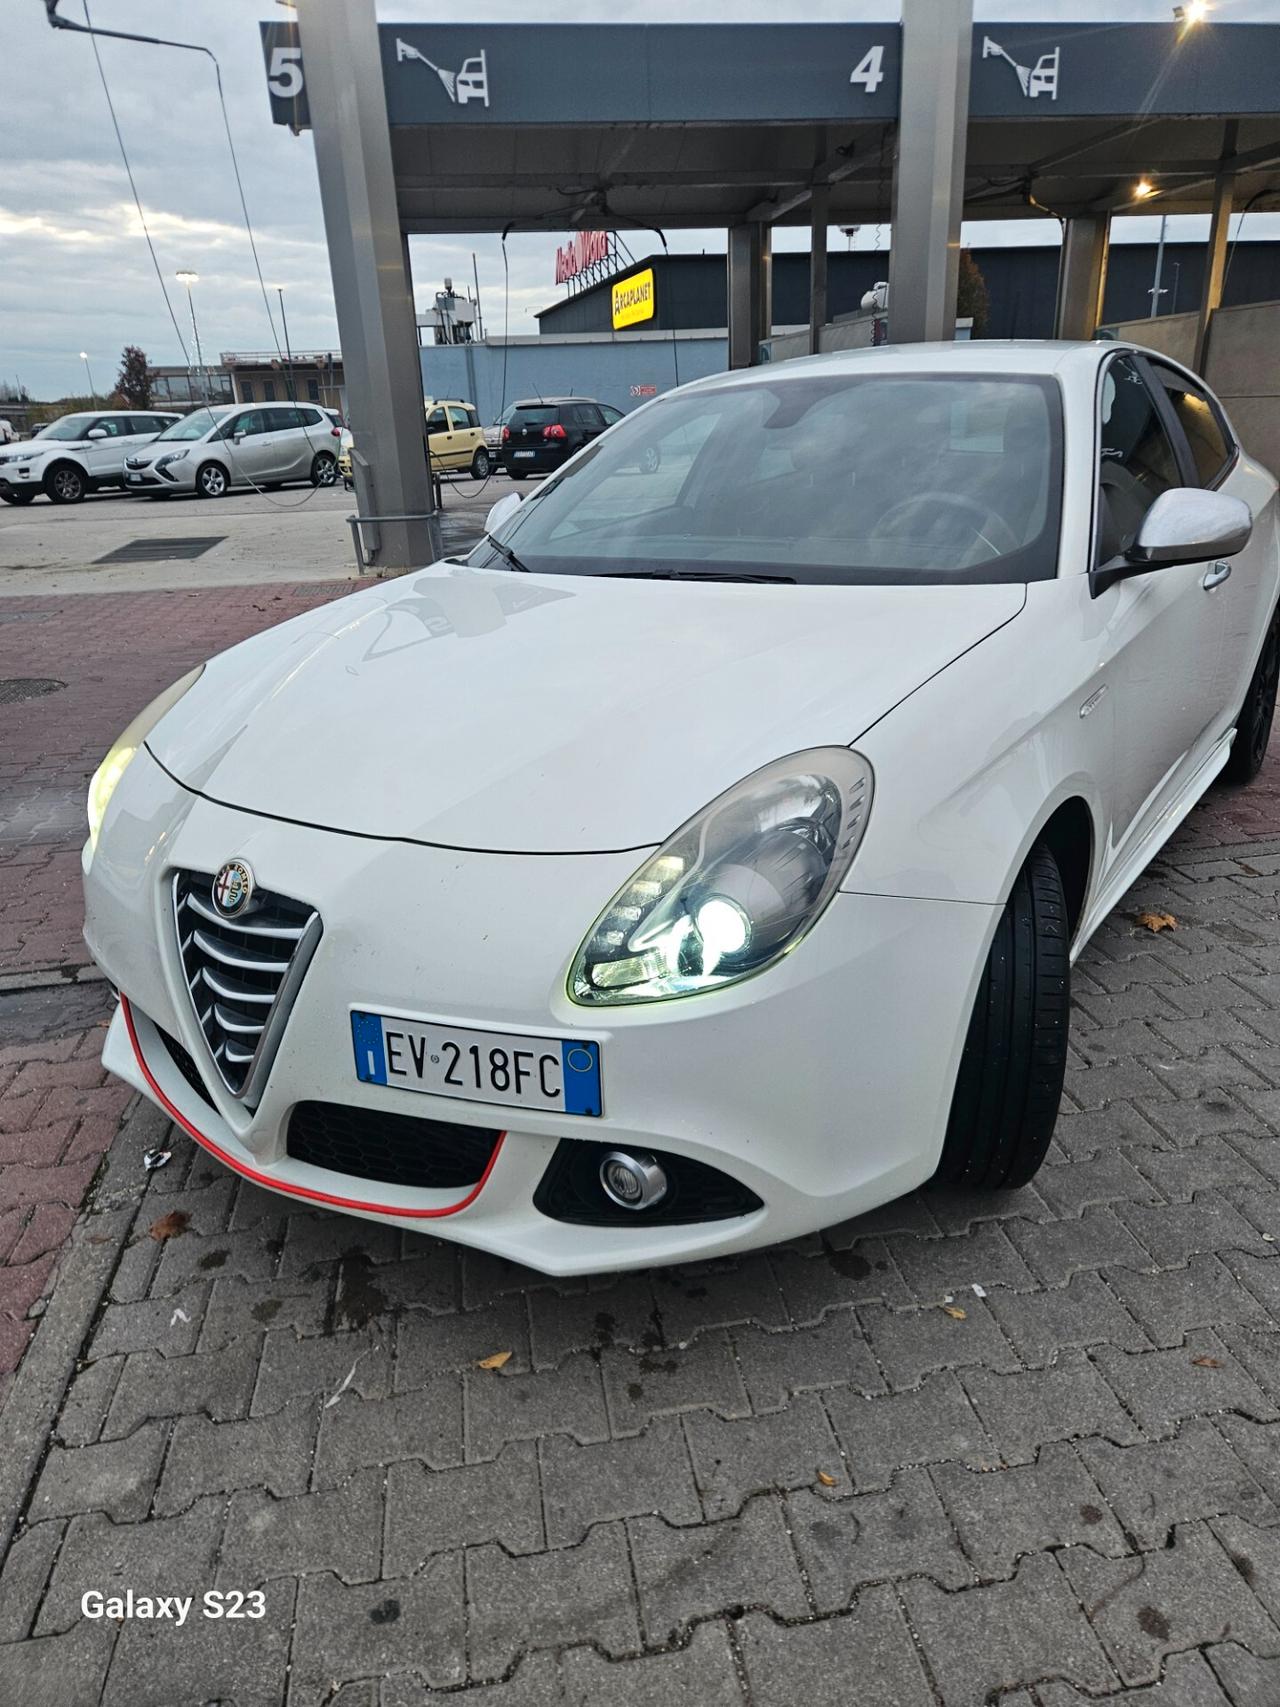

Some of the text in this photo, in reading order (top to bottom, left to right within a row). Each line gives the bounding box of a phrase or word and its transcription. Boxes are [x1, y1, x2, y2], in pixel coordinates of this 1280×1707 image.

[269, 47, 304, 98] 5
[849, 45, 884, 92] 4
[614, 282, 651, 315] ARCAPLANET
